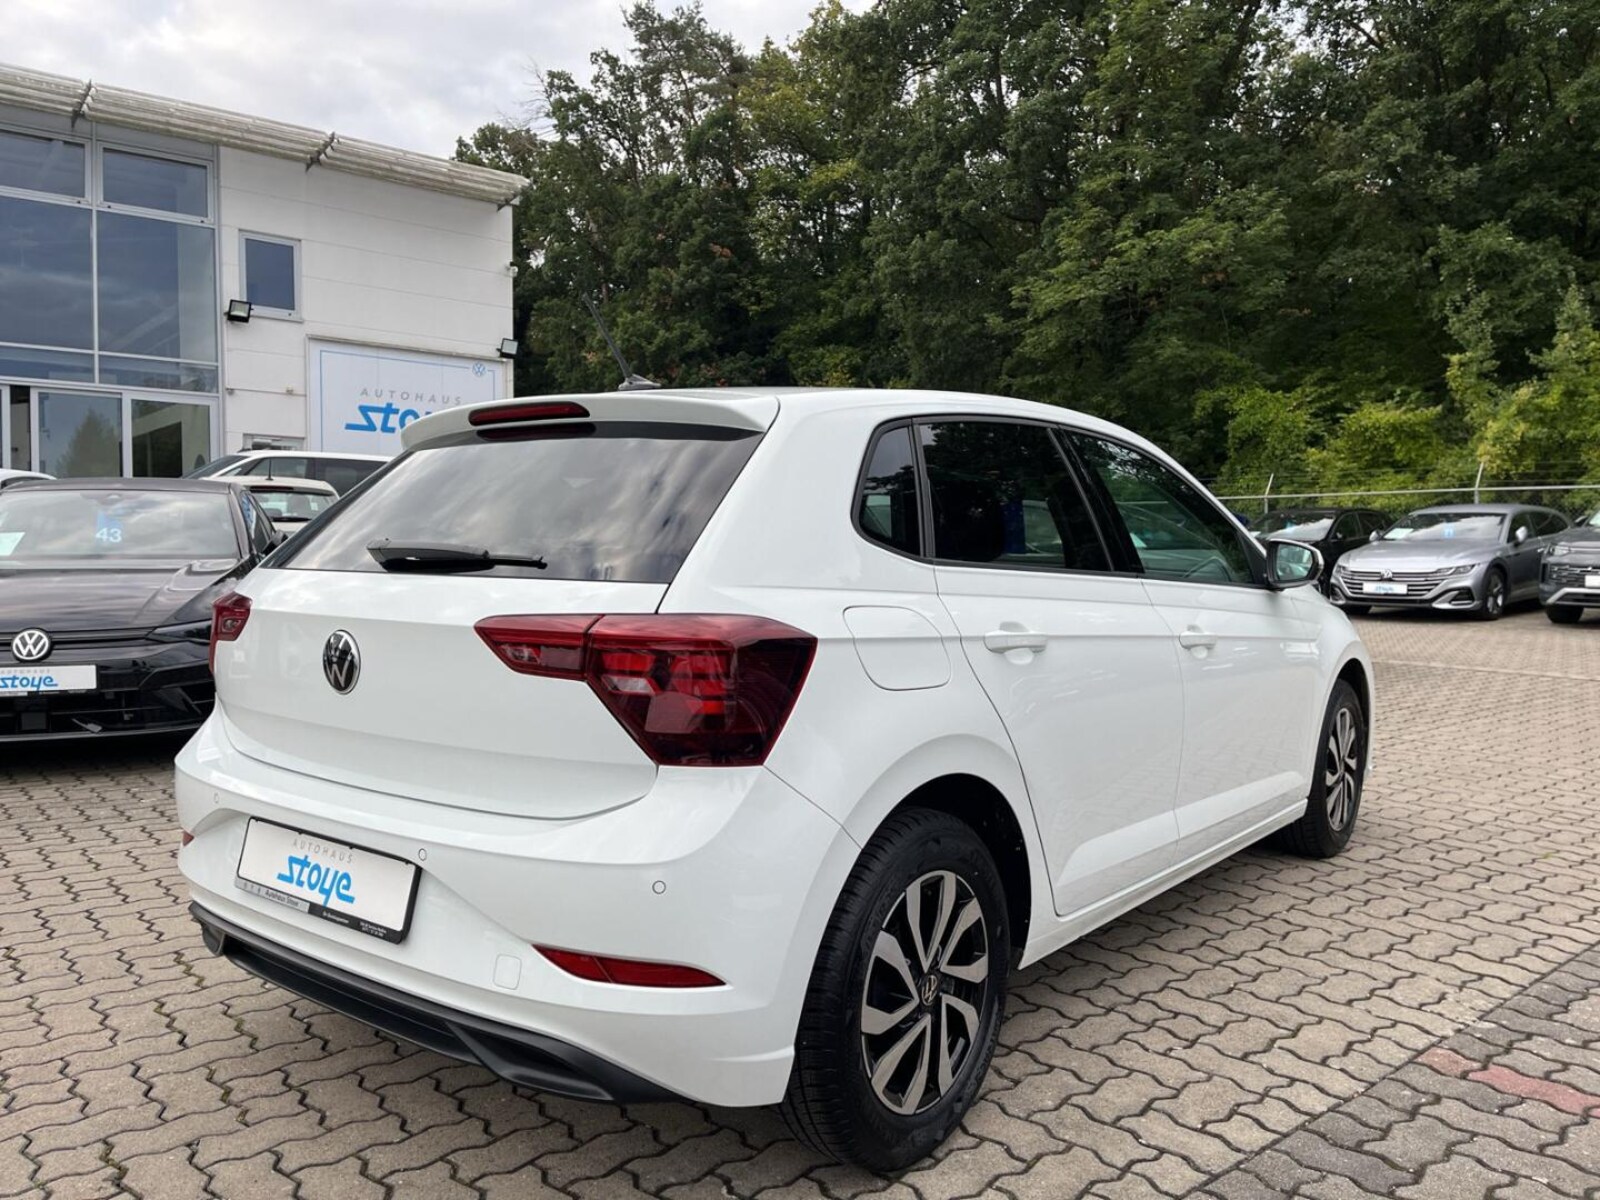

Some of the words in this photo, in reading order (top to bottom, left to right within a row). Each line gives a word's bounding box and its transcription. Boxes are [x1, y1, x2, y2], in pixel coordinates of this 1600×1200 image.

[360, 387, 462, 405] AUTOHAUS
[95, 527, 122, 543] 43
[292, 837, 353, 865] AUTOHAUS
